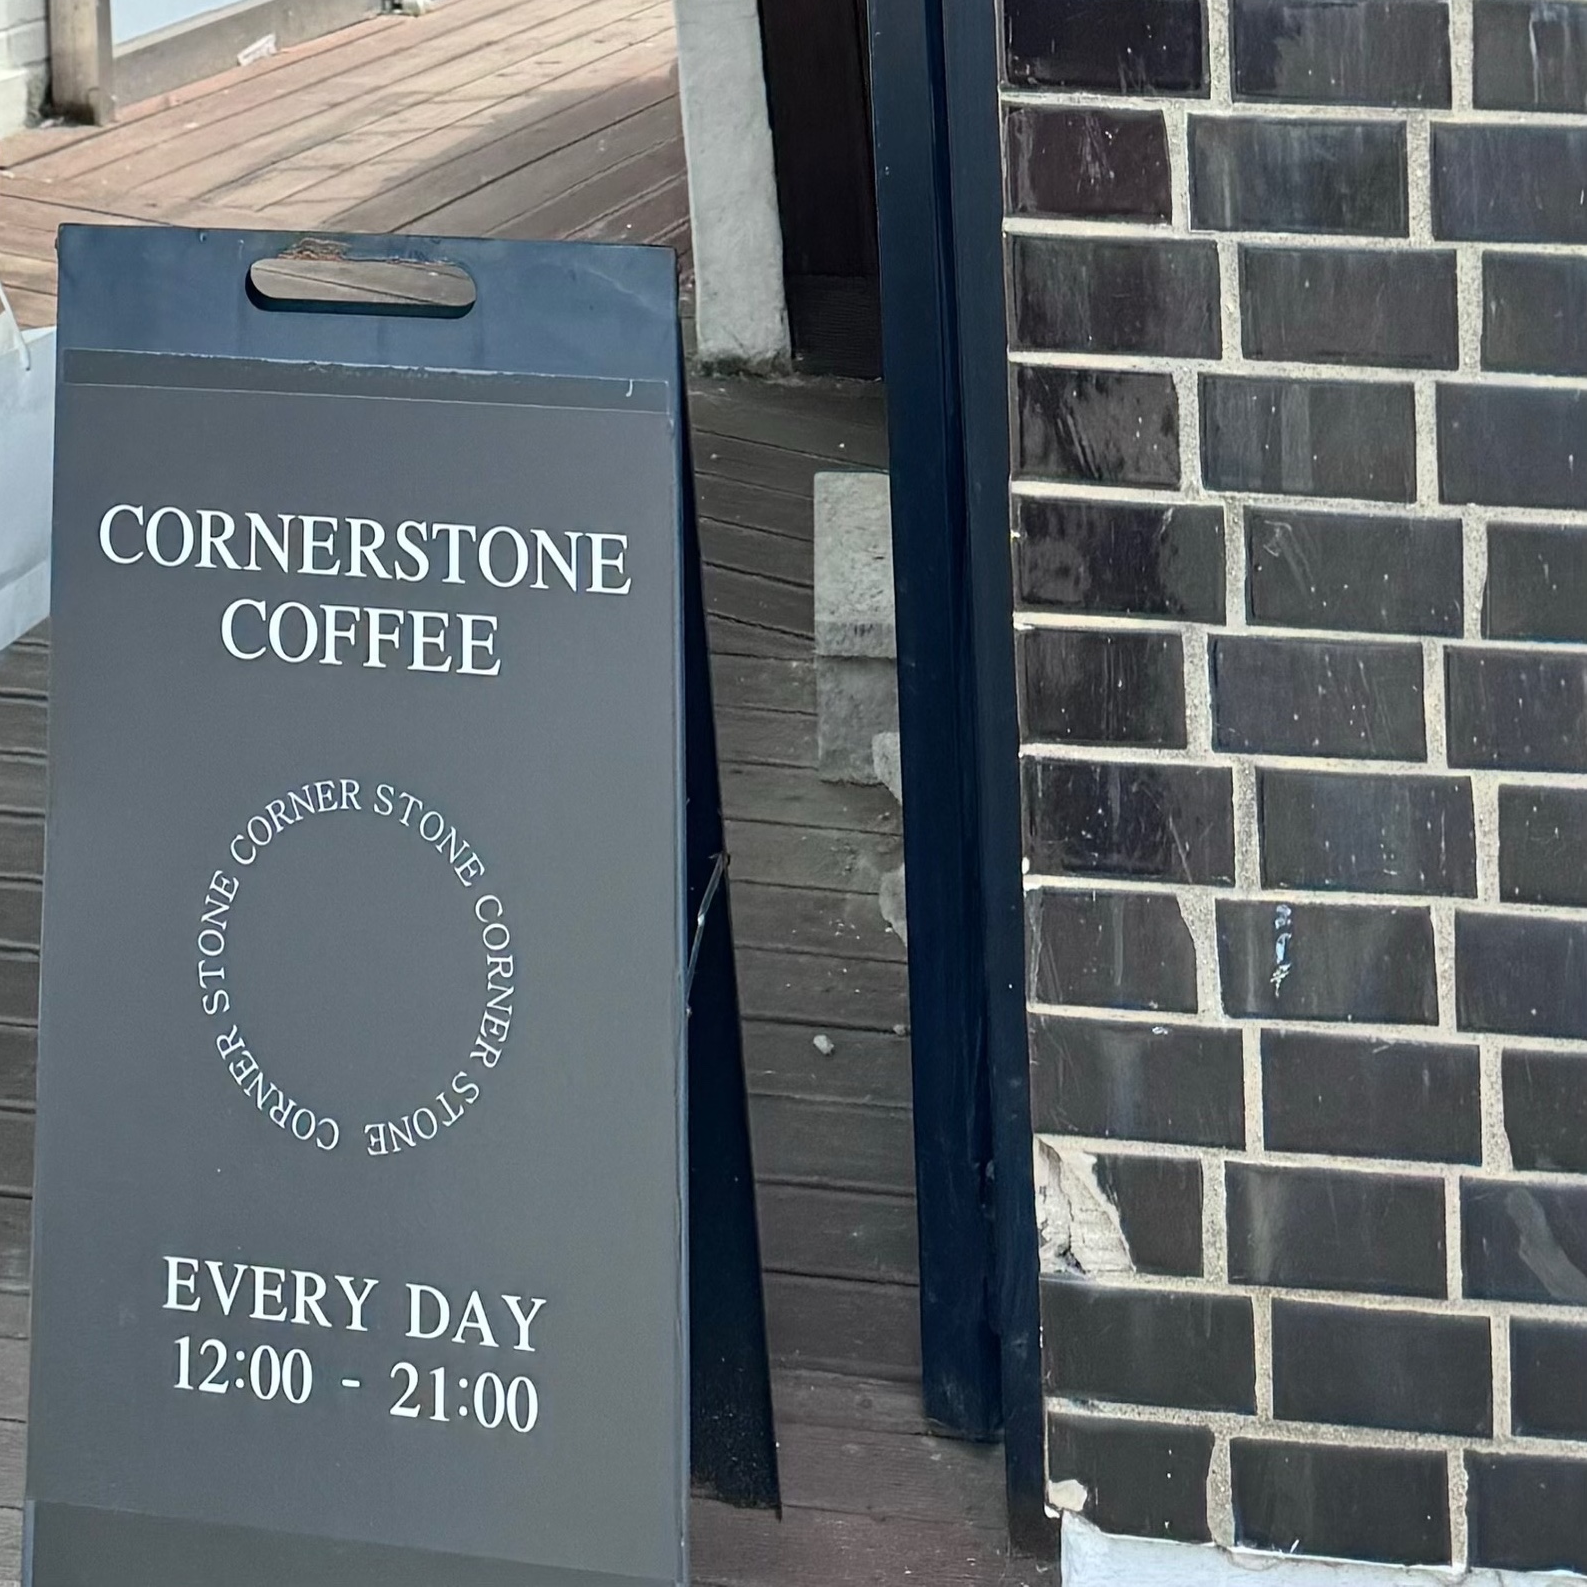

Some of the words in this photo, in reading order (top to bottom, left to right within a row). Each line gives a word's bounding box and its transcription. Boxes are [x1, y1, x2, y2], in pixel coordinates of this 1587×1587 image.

[99, 504, 632, 595] CORNERSTONE
[221, 598, 501, 676] COFFEE
[230, 778, 362, 865] CORNER
[373, 783, 485, 887] STONE
[198, 870, 240, 1015] STONE
[470, 894, 515, 1068] CORNER
[216, 1025, 340, 1150] CORNER
[364, 1071, 480, 1155] STONE
[162, 1255, 379, 1332] EVERY
[405, 1283, 547, 1352] DAY
[174, 1336, 313, 1404] 12:00
[389, 1361, 539, 1433] 21:00
